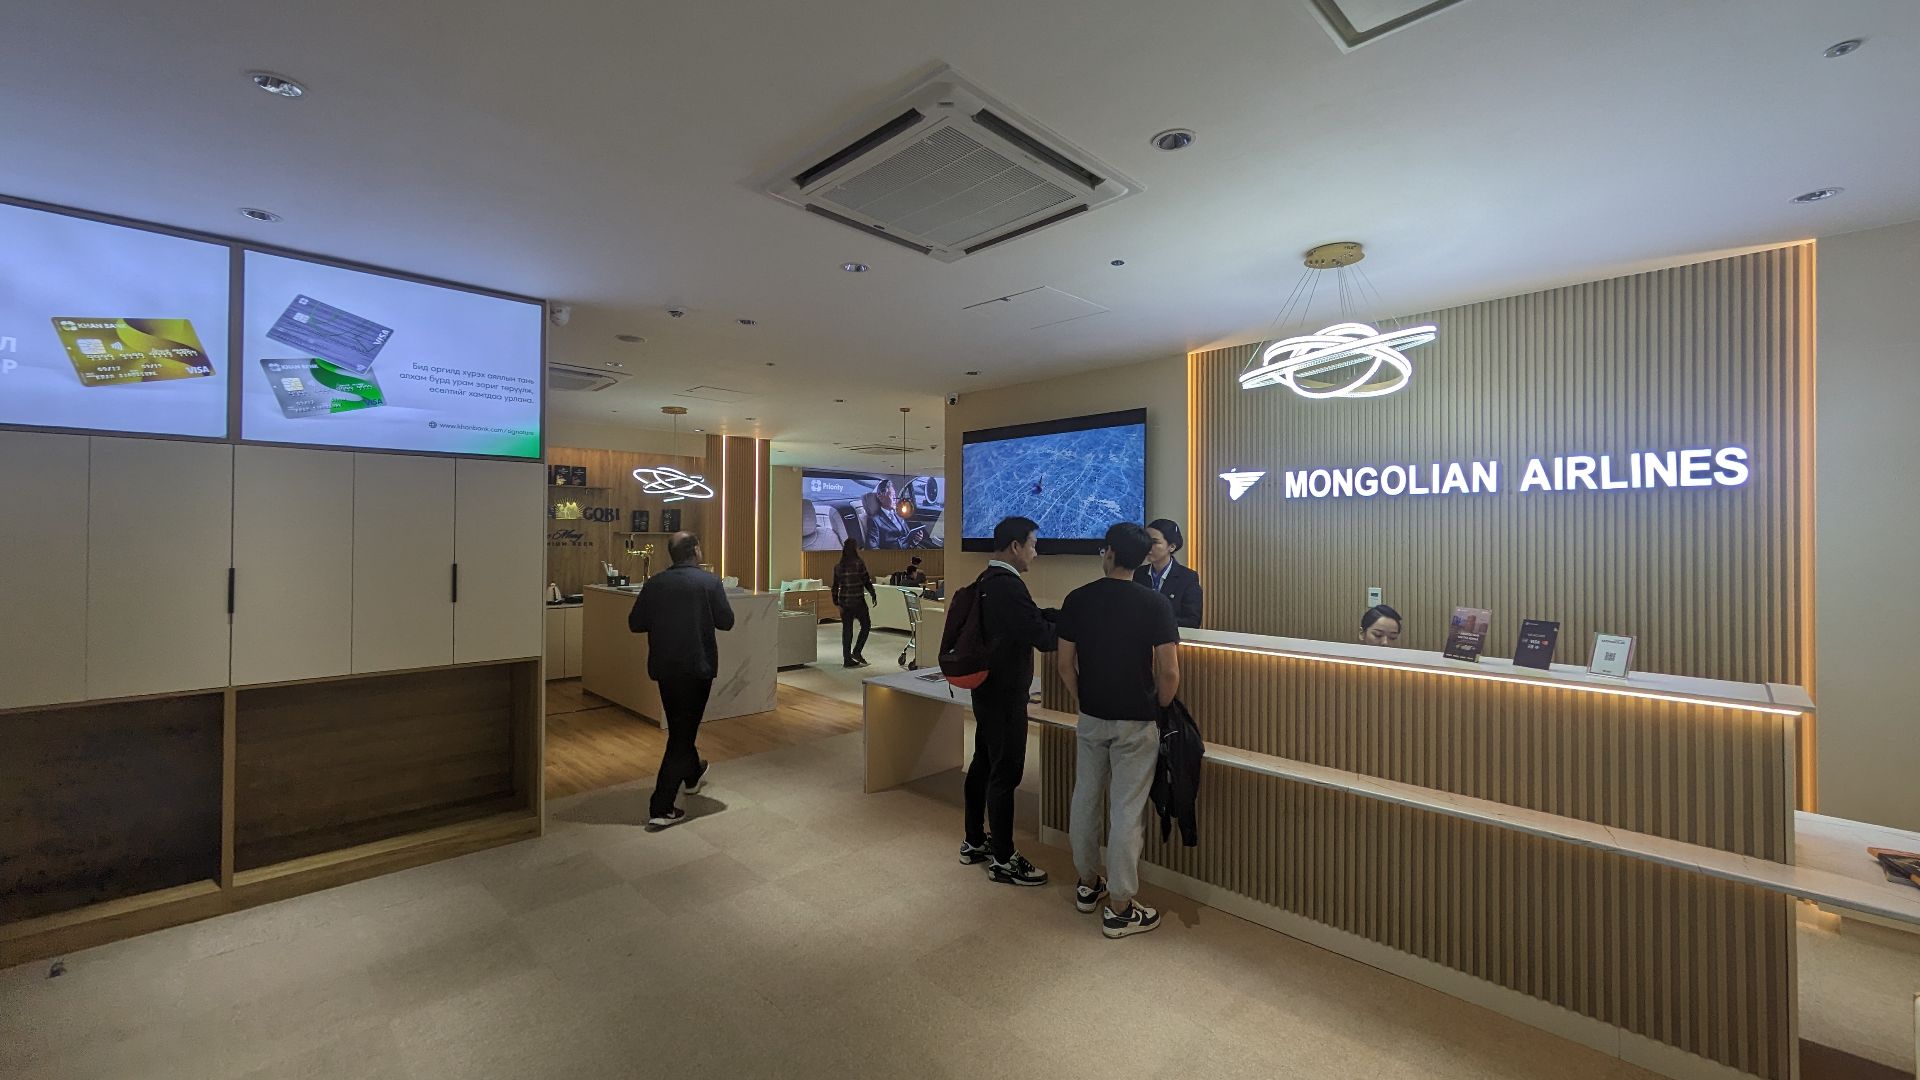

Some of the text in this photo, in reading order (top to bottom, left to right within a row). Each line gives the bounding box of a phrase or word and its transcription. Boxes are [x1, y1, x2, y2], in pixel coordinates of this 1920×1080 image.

[373, 329, 390, 345] VISA
[185, 365, 210, 374] VISA
[412, 362, 429, 371] Бид
[430, 365, 461, 376] оргилд
[399, 373, 427, 381] алхам
[452, 379, 474, 388] урам
[1285, 446, 1749, 499] MONGOLIAN AIRLINES
[822, 482, 844, 493] Priority
